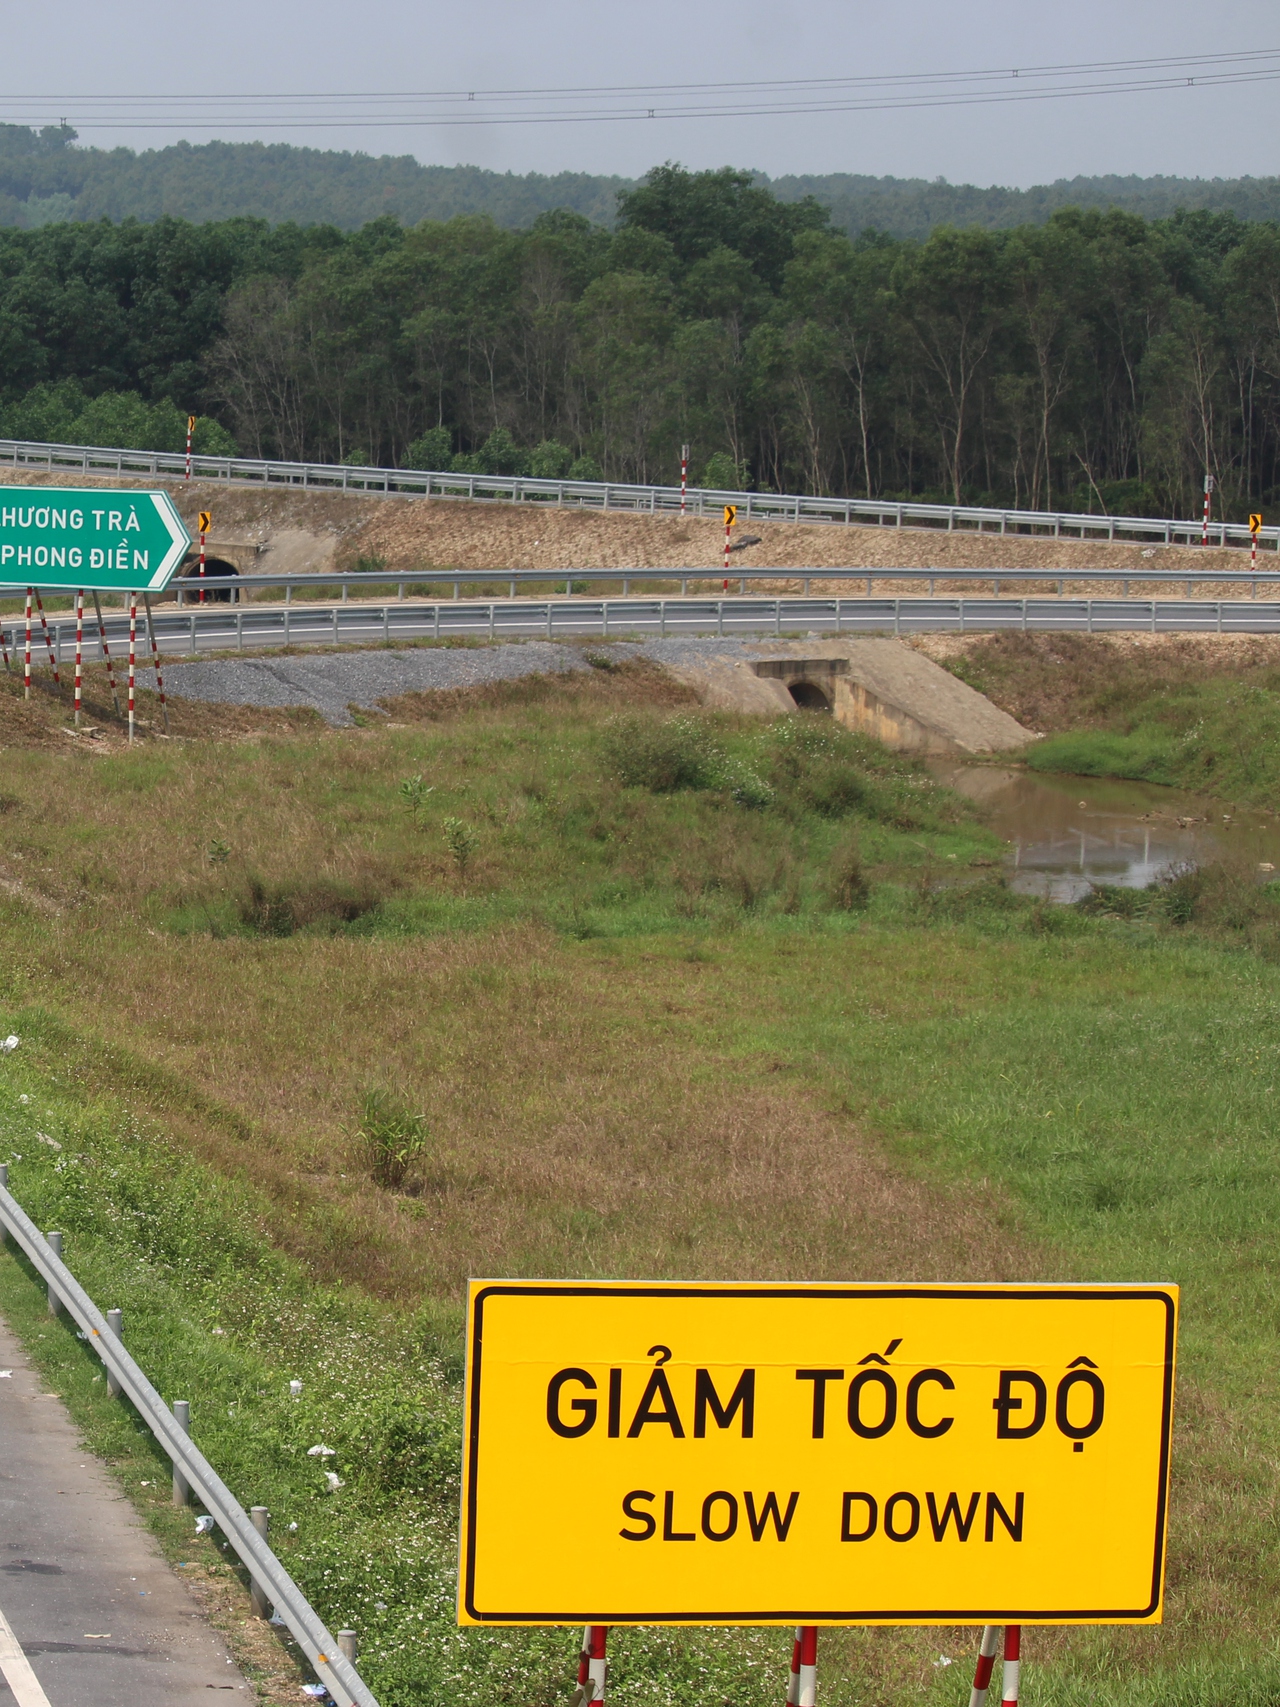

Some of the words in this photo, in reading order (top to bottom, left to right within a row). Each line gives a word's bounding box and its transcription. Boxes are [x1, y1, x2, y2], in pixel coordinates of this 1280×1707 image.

[92, 505, 140, 531] TRÀ
[89, 538, 149, 570] ĐIỀN
[547, 1345, 755, 1438] GIẢM
[796, 1339, 955, 1439] TỐC
[993, 1356, 1104, 1452] ĐỘ
[619, 1490, 799, 1542] SLOW
[841, 1492, 1024, 1542] DOWN
